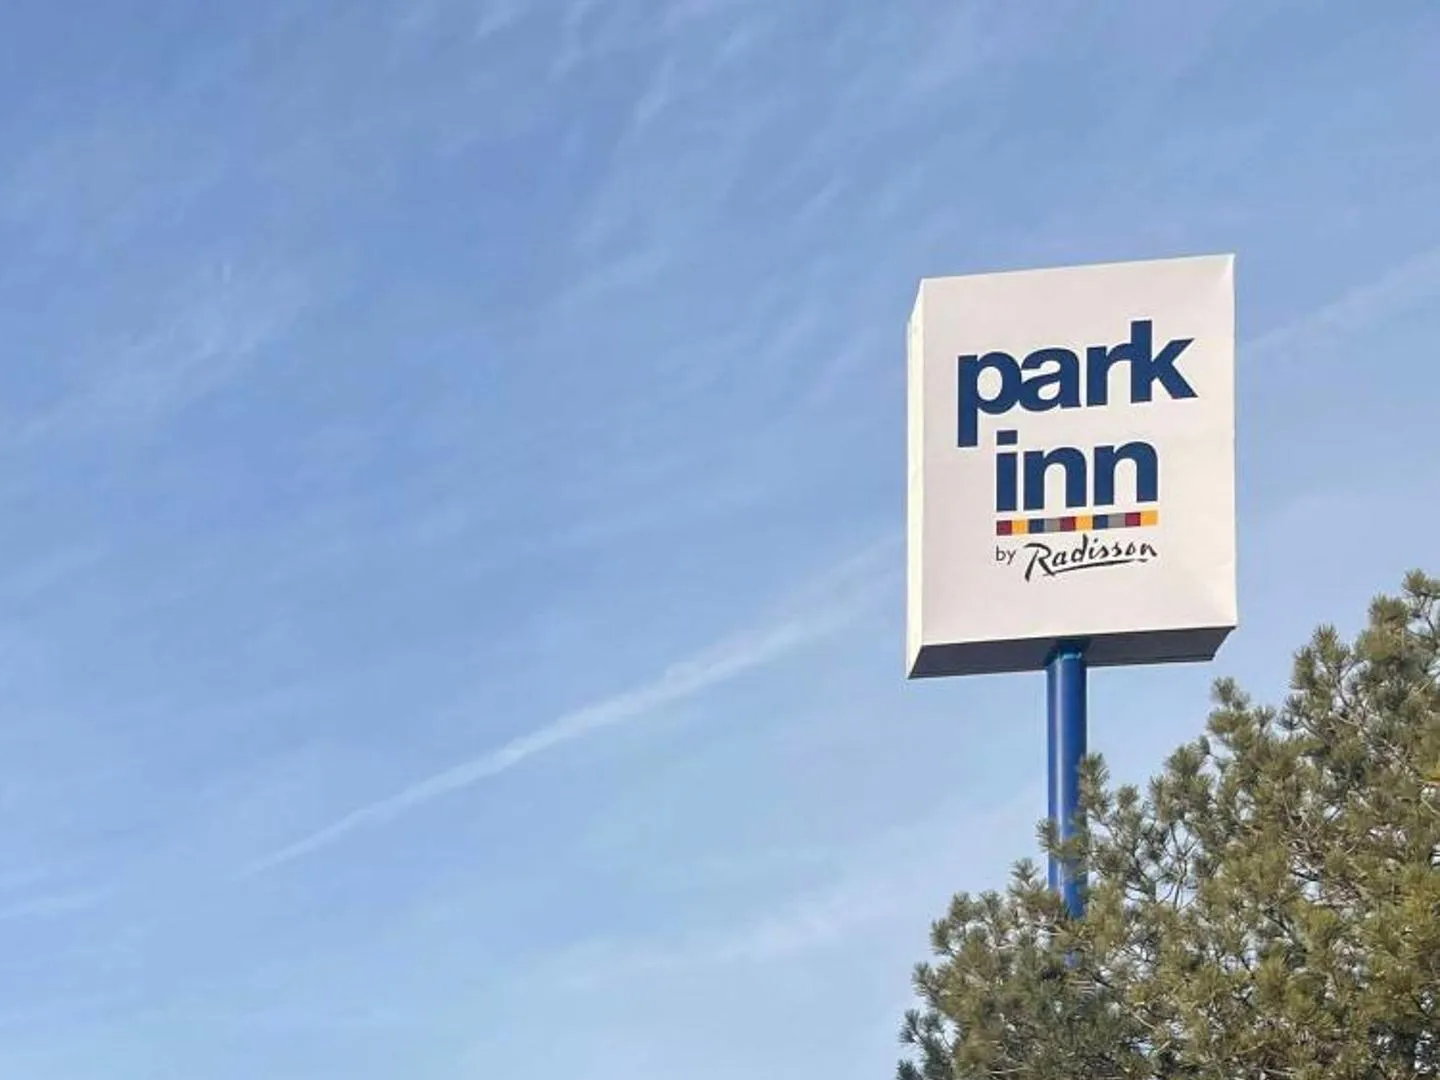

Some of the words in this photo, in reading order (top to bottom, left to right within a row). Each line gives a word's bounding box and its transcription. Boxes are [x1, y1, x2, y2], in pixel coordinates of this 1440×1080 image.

[958, 320, 1198, 448] park
[996, 430, 1158, 512] inn
[996, 544, 1017, 565] by
[1023, 533, 1158, 581] Radisson
